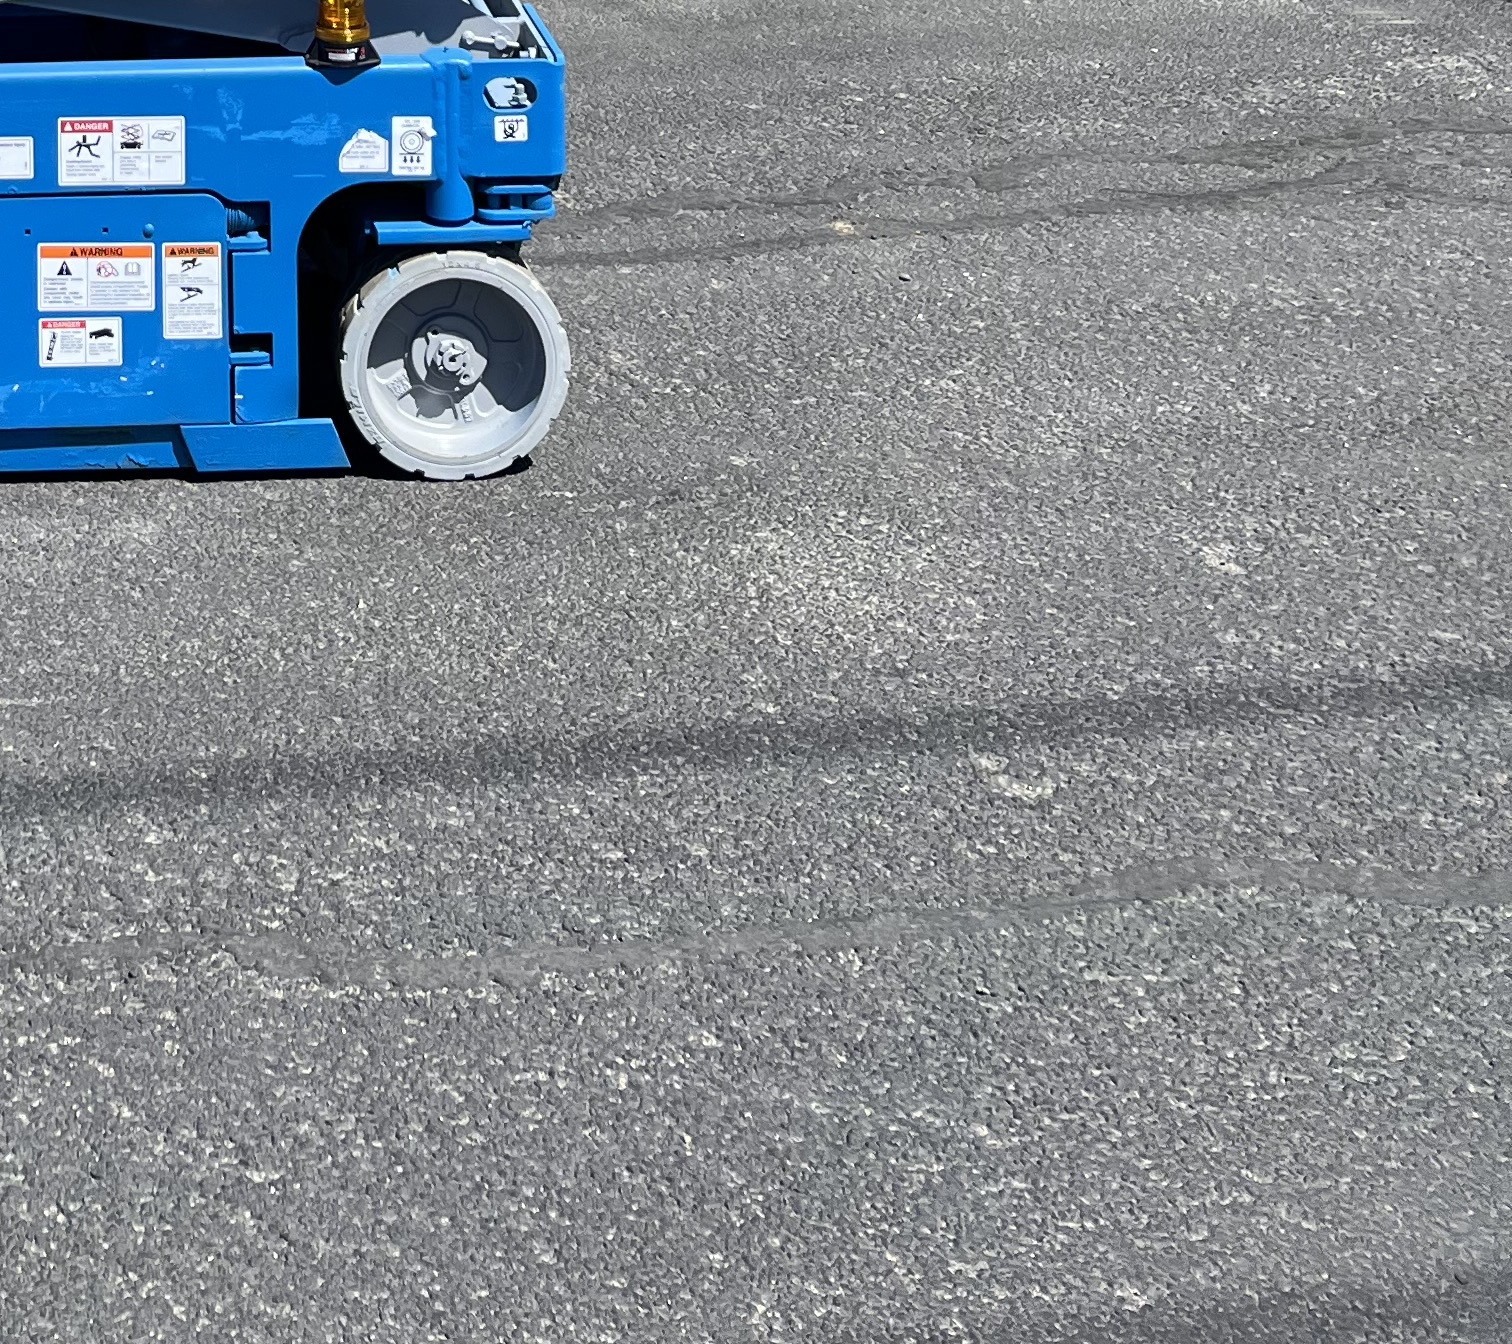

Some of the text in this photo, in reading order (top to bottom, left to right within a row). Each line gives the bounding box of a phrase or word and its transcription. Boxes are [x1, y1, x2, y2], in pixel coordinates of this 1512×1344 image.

[74, 122, 109, 131] DANGER
[80, 247, 123, 257] WARNING
[178, 246, 214, 255] WARNING
